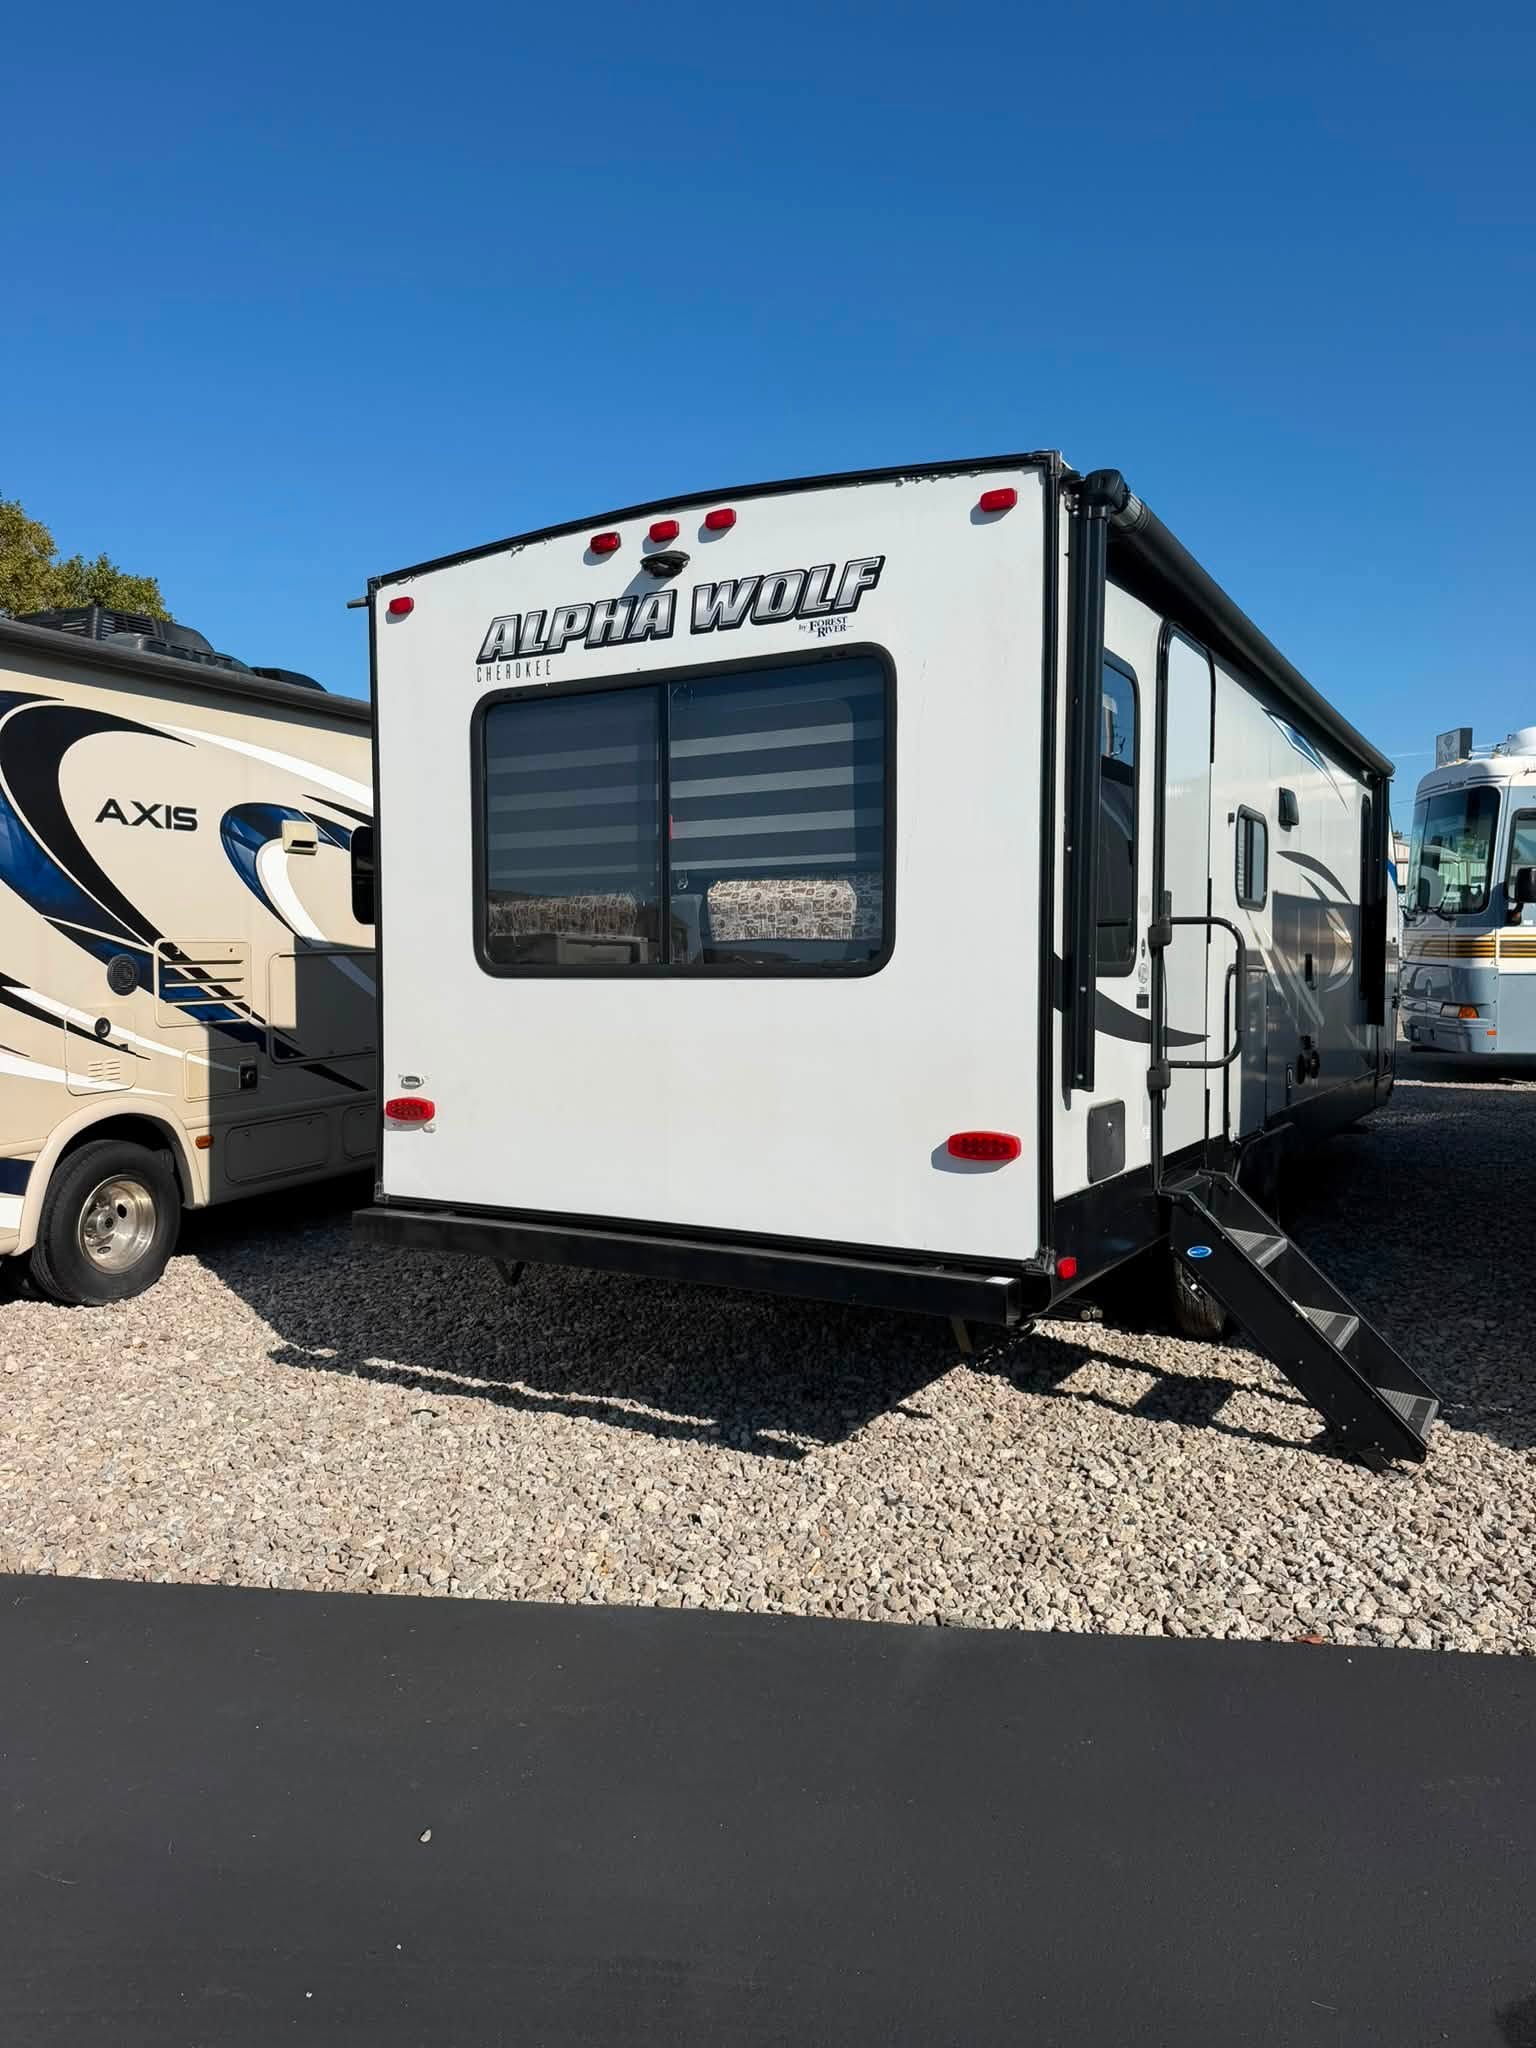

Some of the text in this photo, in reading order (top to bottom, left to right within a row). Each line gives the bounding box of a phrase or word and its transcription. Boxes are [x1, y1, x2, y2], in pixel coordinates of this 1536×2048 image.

[476, 555, 886, 665] ALPHA WOLF
[810, 616, 848, 631] FOREST
[817, 624, 847, 637] RIVER
[476, 659, 551, 682] CHEROKEE
[94, 798, 198, 831] AXIS
